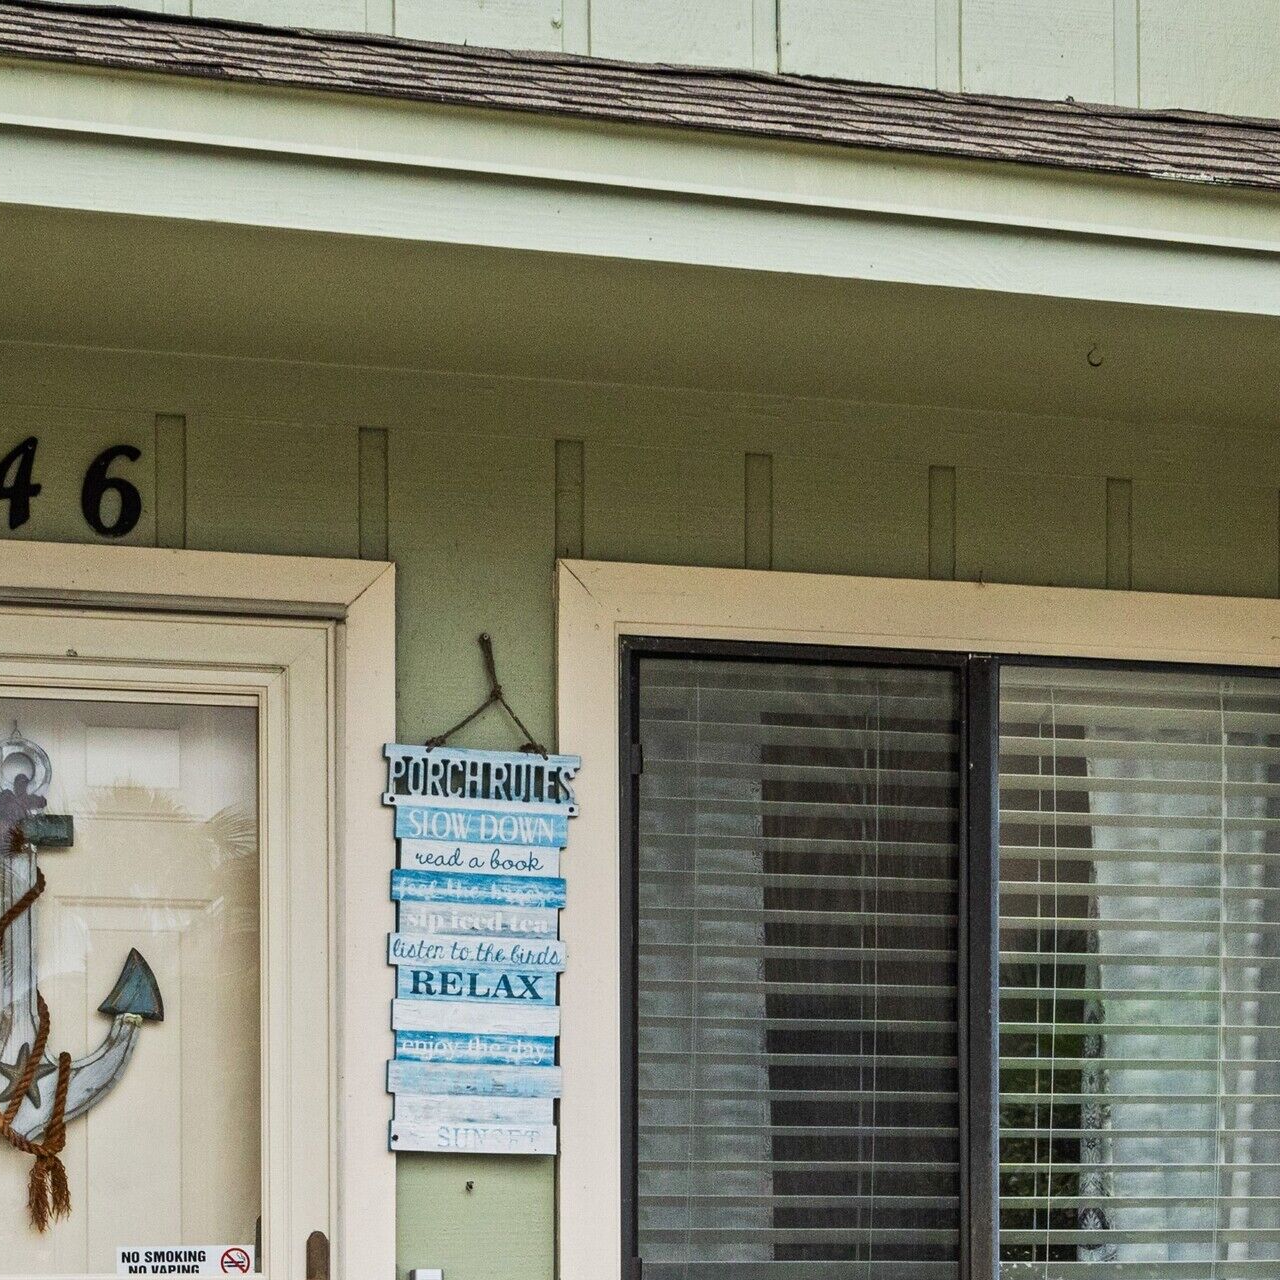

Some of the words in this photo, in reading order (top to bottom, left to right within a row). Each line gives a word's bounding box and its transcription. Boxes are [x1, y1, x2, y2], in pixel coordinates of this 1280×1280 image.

[388, 755, 482, 799] PORCH
[489, 761, 577, 805] RULES
[408, 809, 470, 839] SLOW
[479, 814, 554, 843] DOWN
[415, 847, 463, 867] read
[468, 856, 485, 869] a
[490, 848, 544, 872] book
[406, 909, 444, 935] sip
[450, 910, 503, 931] iced
[509, 914, 549, 933] tea
[393, 938, 445, 959] listen
[451, 941, 470, 961] to
[476, 943, 506, 963] the
[510, 944, 562, 966] birds
[410, 970, 543, 1000] RELAX
[402, 1035, 460, 1060] enjoy
[468, 1038, 501, 1055] the
[509, 1039, 548, 1065] day
[121, 1251, 140, 1264] NO
[144, 1250, 207, 1263] SMOKING
[151, 1264, 200, 1274] VAPING
